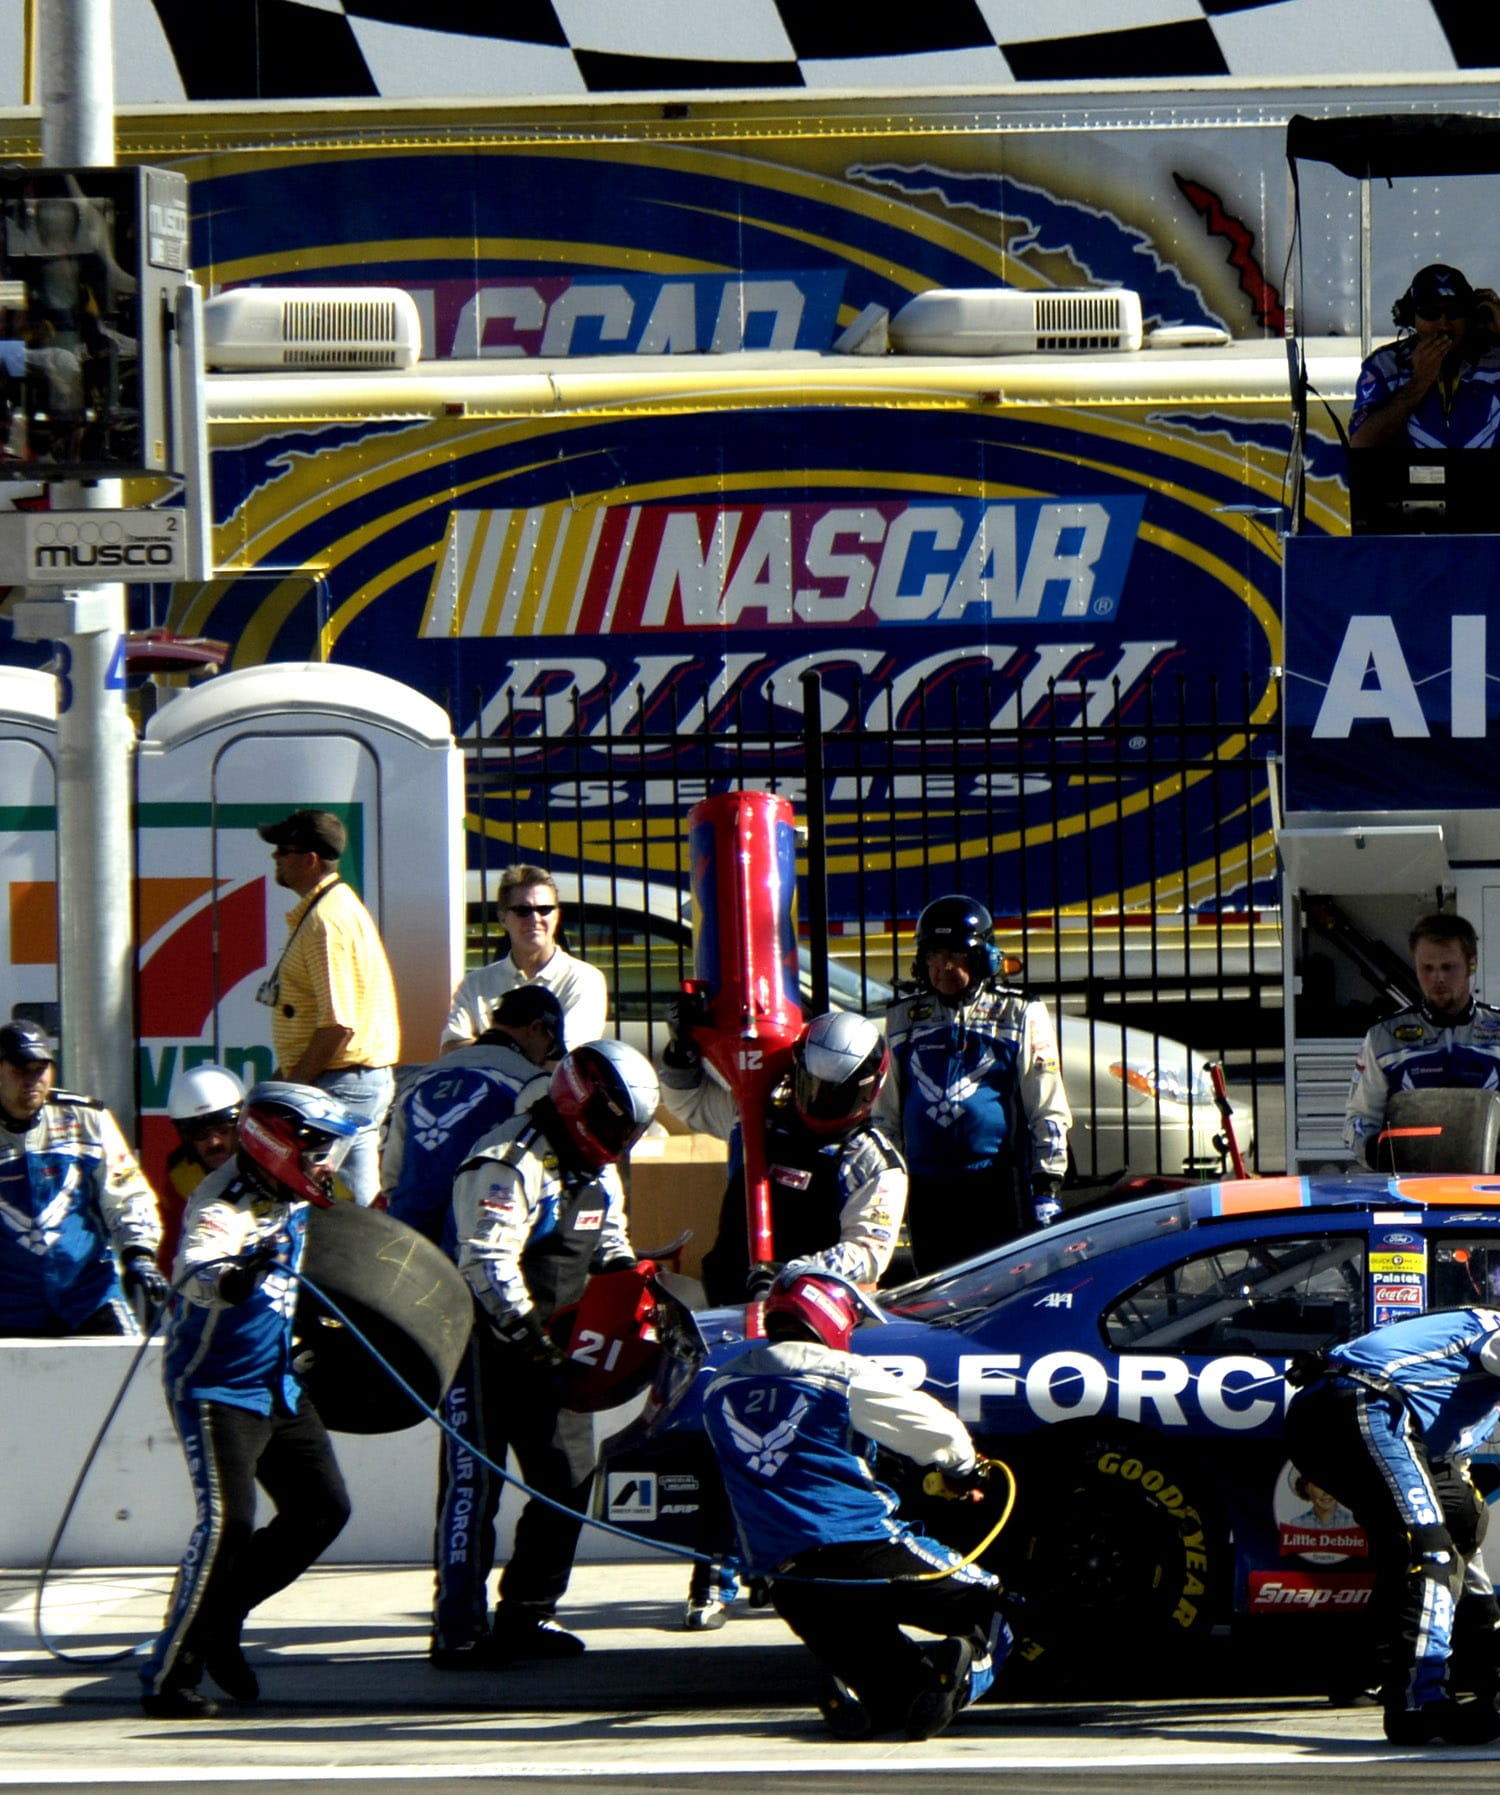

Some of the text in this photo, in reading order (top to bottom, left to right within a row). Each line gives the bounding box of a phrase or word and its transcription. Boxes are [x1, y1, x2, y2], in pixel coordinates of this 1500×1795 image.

[166, 517, 177, 531] 2
[36, 544, 173, 567] musco
[738, 1049, 764, 1071] 21
[433, 1079, 464, 1100] 21
[571, 1329, 624, 1373] 21
[744, 1387, 778, 1414] 21
[957, 1351, 1295, 1431] FORC
[449, 1387, 474, 1565] U.S AIR FORCE
[1097, 1451, 1208, 1629] GOODYEAR
[1283, 1533, 1365, 1548] Little Debbie
[1253, 1582, 1373, 1608] Snap-on
